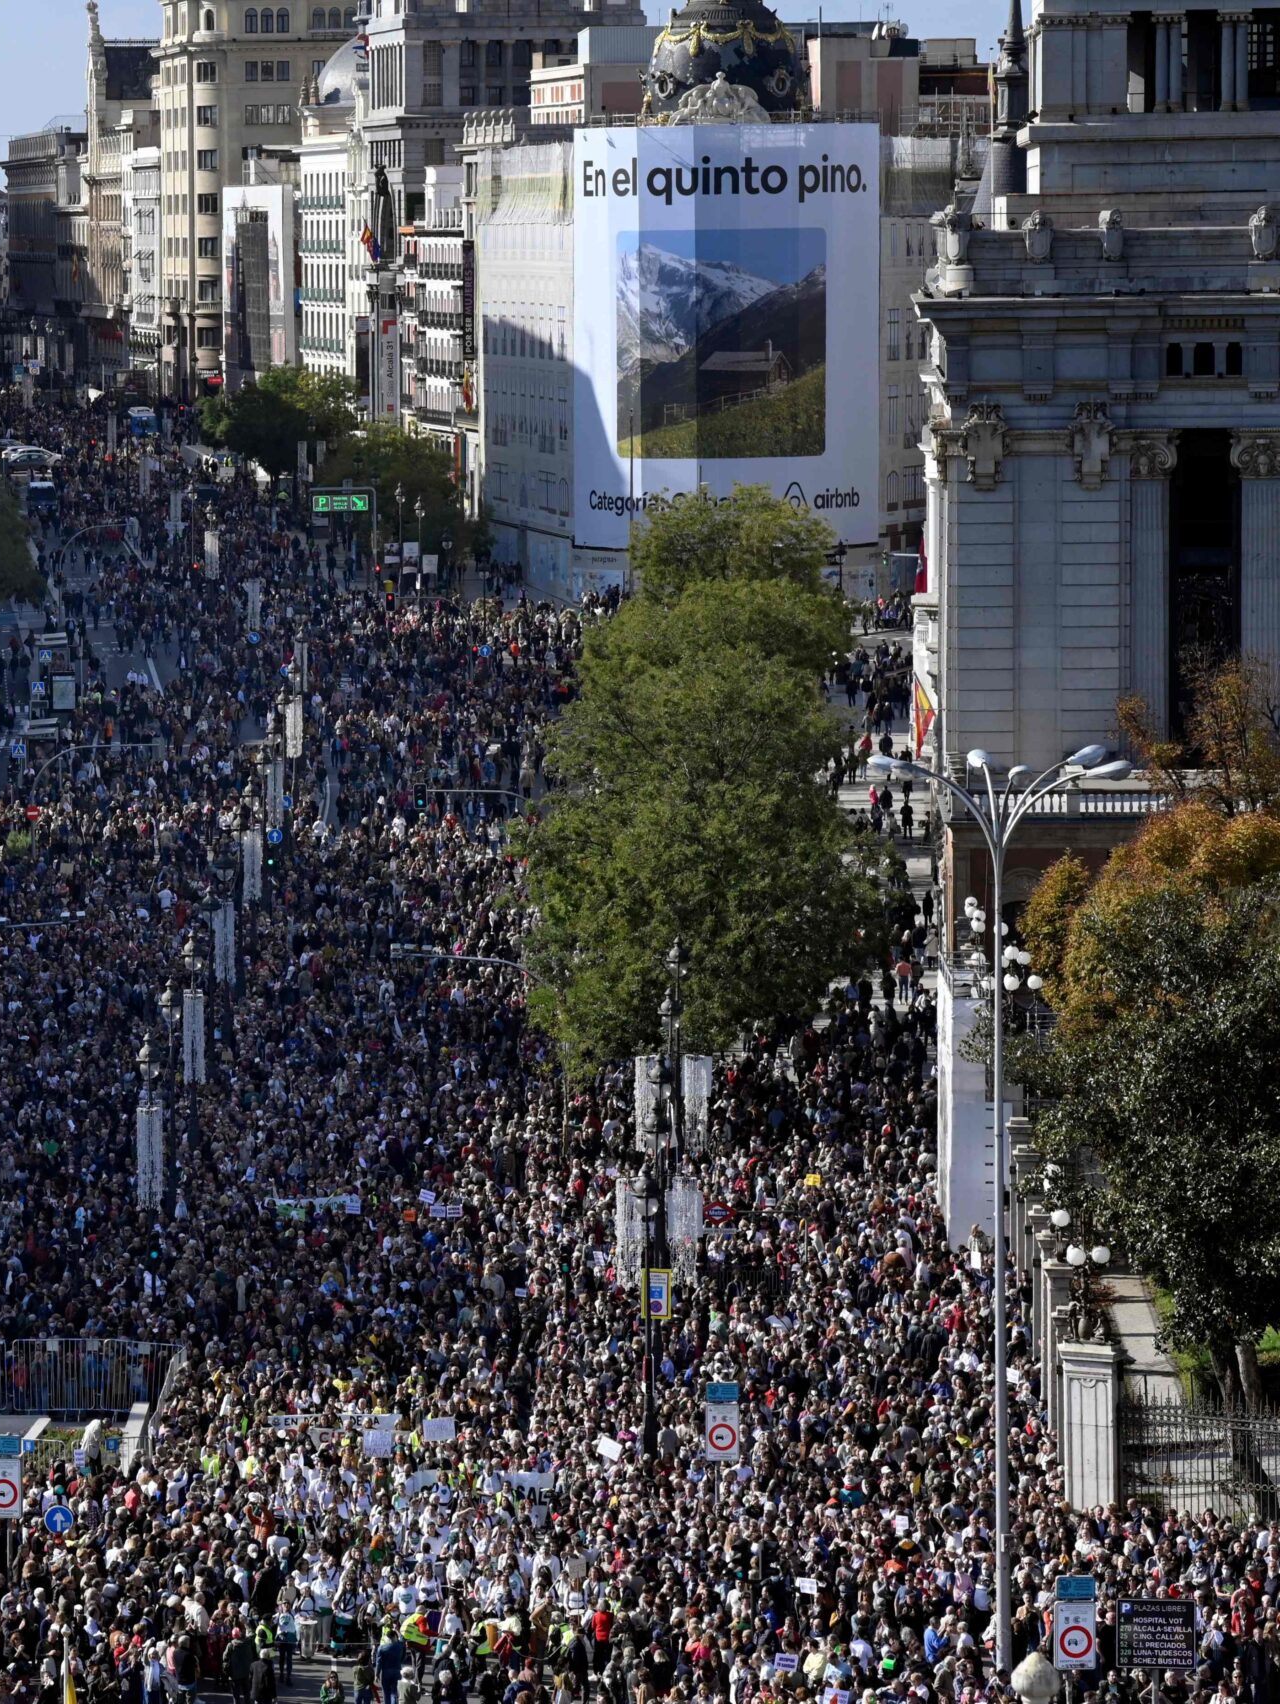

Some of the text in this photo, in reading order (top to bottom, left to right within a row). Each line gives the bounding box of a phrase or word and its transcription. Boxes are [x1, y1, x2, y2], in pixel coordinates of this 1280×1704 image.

[583, 153, 867, 205] En el quinto pino.
[387, 341, 394, 350] 31
[385, 351, 394, 378] Alcalá
[813, 486, 860, 510] airbnb
[284, 1417, 298, 1427] EN
[1121, 1602, 1131, 1613] P
[1133, 1604, 1160, 1612] PLAZAS
[1133, 1625, 1192, 1633] ALCALA-SEVILLA
[1157, 1657, 1192, 1665] BUSTILLO
